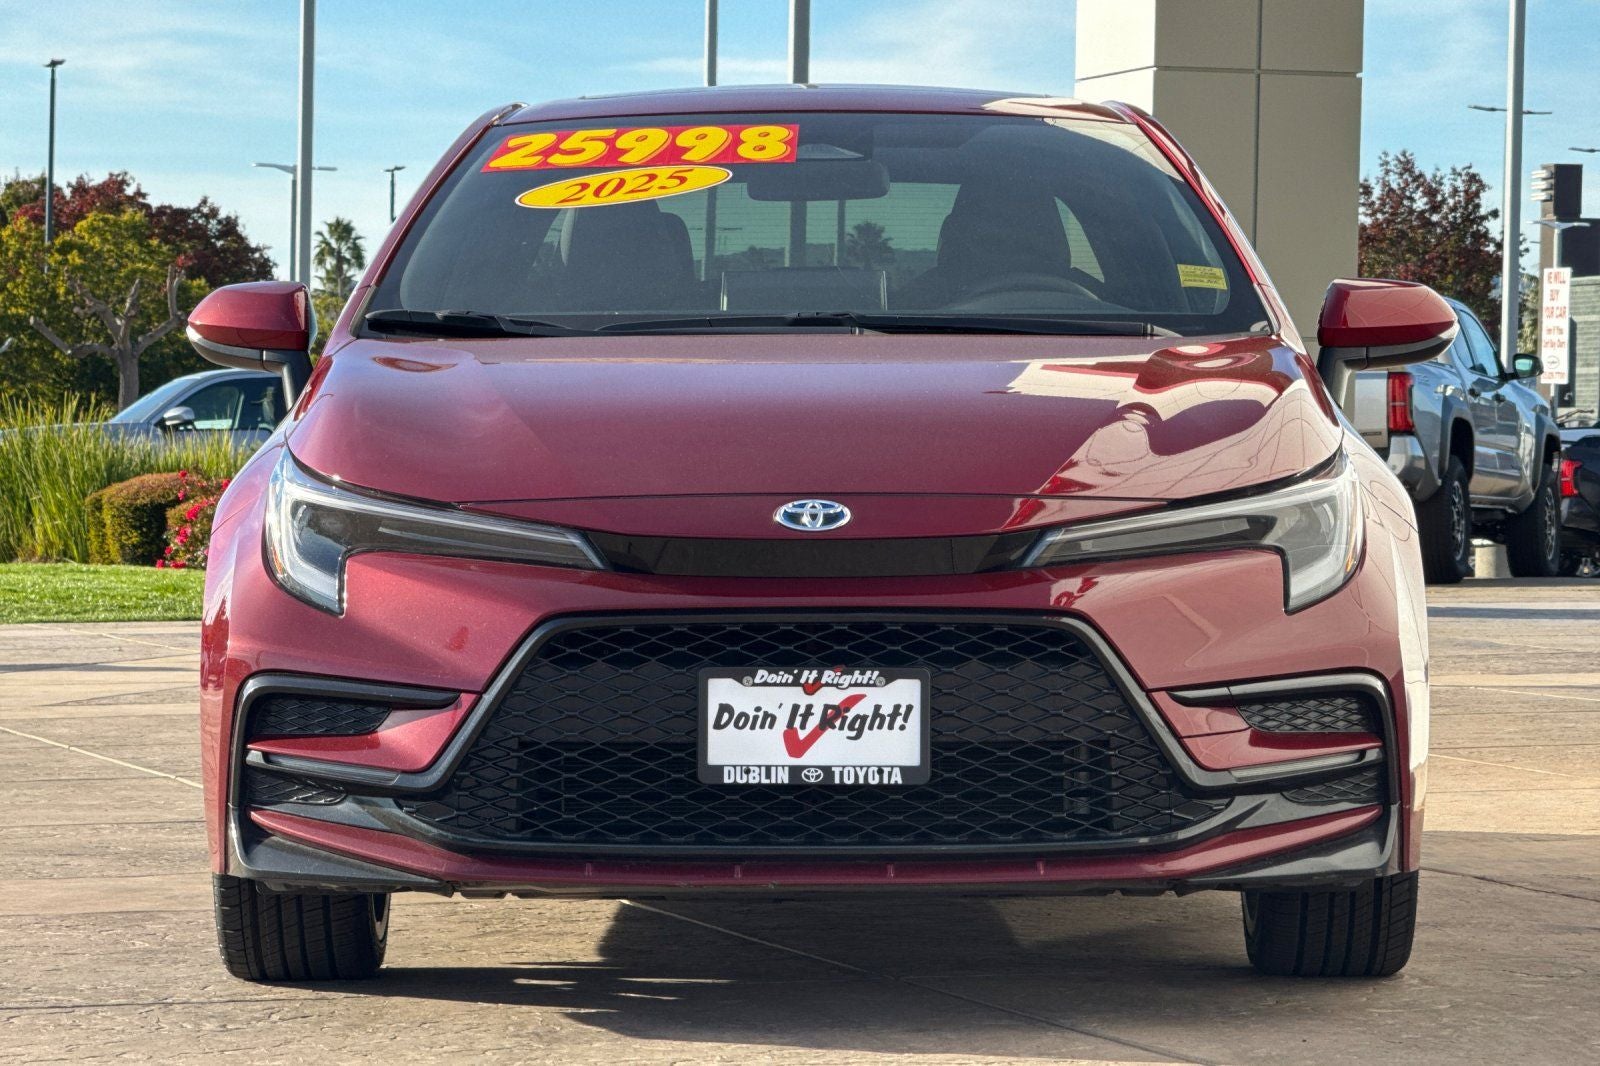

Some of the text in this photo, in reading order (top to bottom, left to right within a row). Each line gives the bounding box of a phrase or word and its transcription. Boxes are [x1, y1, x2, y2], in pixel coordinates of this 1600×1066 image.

[489, 125, 795, 167] 25998
[555, 168, 694, 204] 2025
[753, 669, 880, 689] Doin' It Right!
[712, 702, 914, 741] Doin' It Right!
[723, 766, 903, 785] DUBLIN TOYOTA
